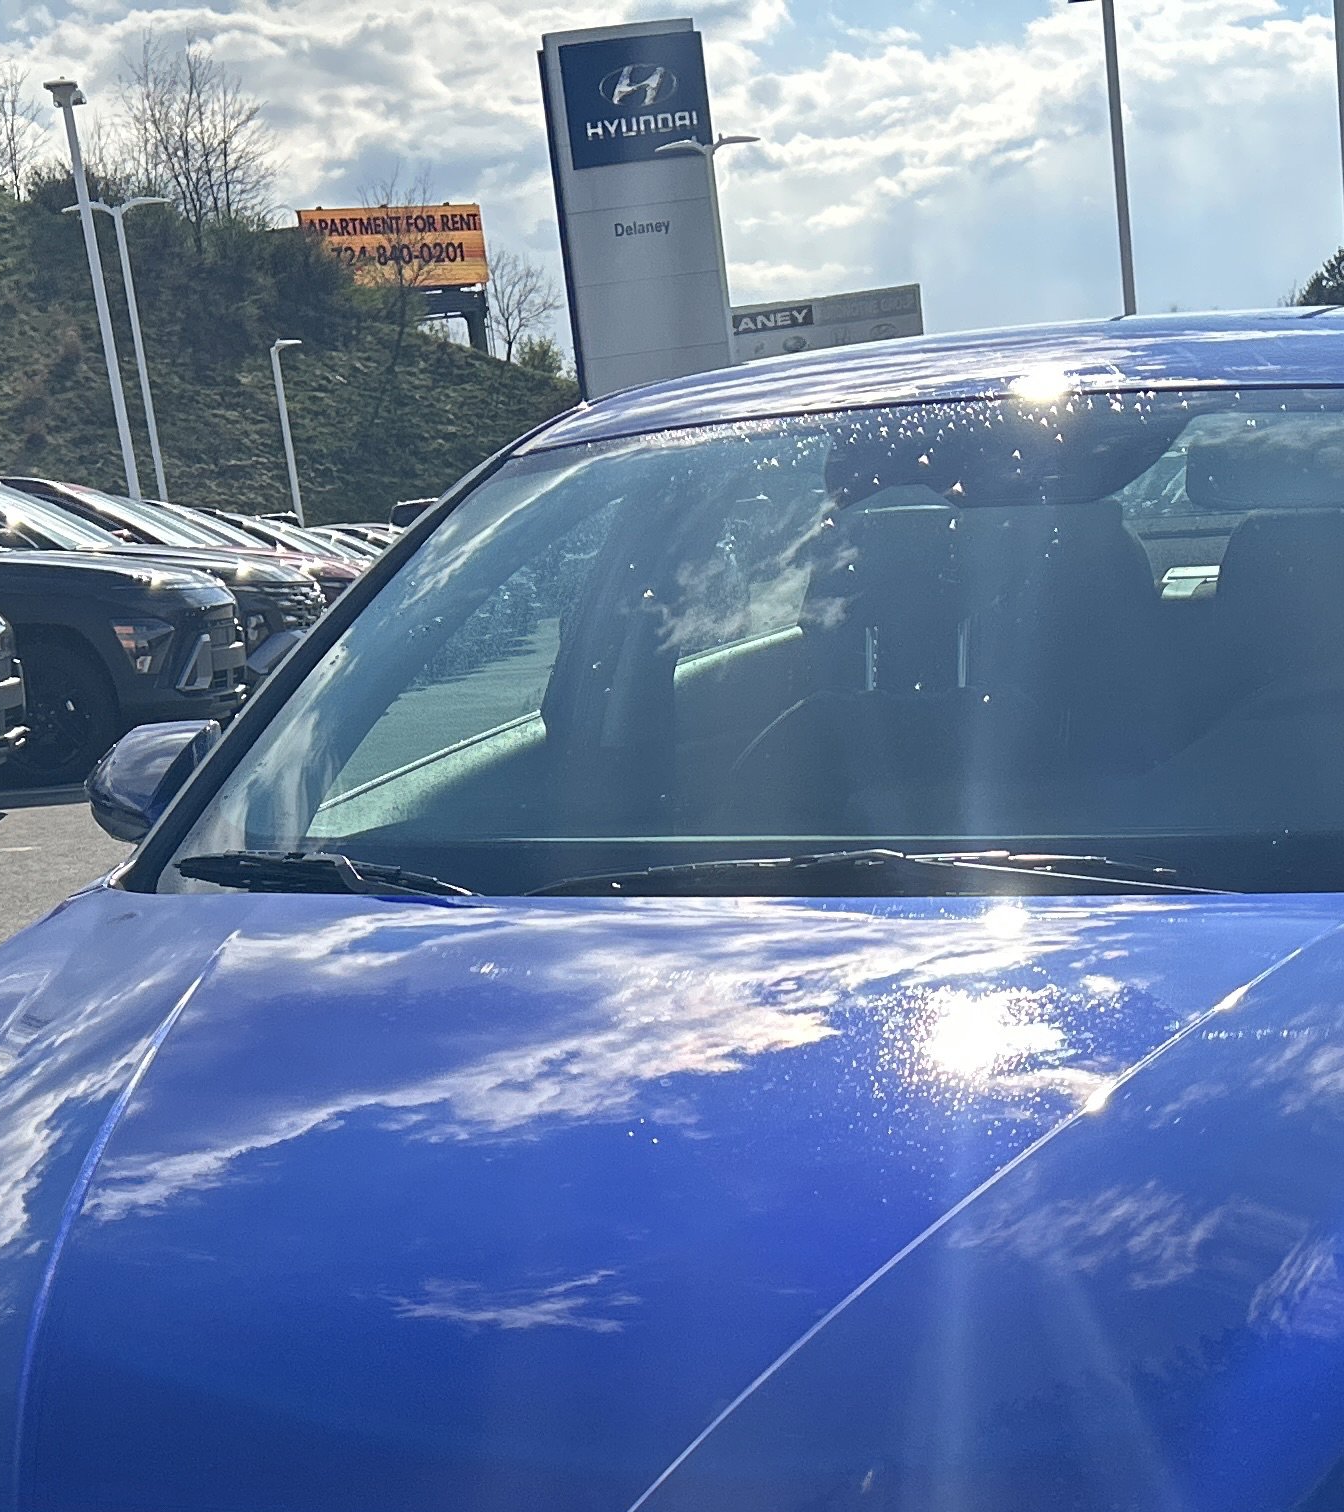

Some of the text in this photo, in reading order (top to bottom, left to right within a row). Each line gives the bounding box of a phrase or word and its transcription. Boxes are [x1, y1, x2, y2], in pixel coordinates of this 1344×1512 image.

[586, 111, 699, 140] HYUNDAI
[307, 213, 479, 237] APARTMENT FOR RENT
[614, 221, 670, 237] Delaney
[735, 308, 809, 332] ANEY
